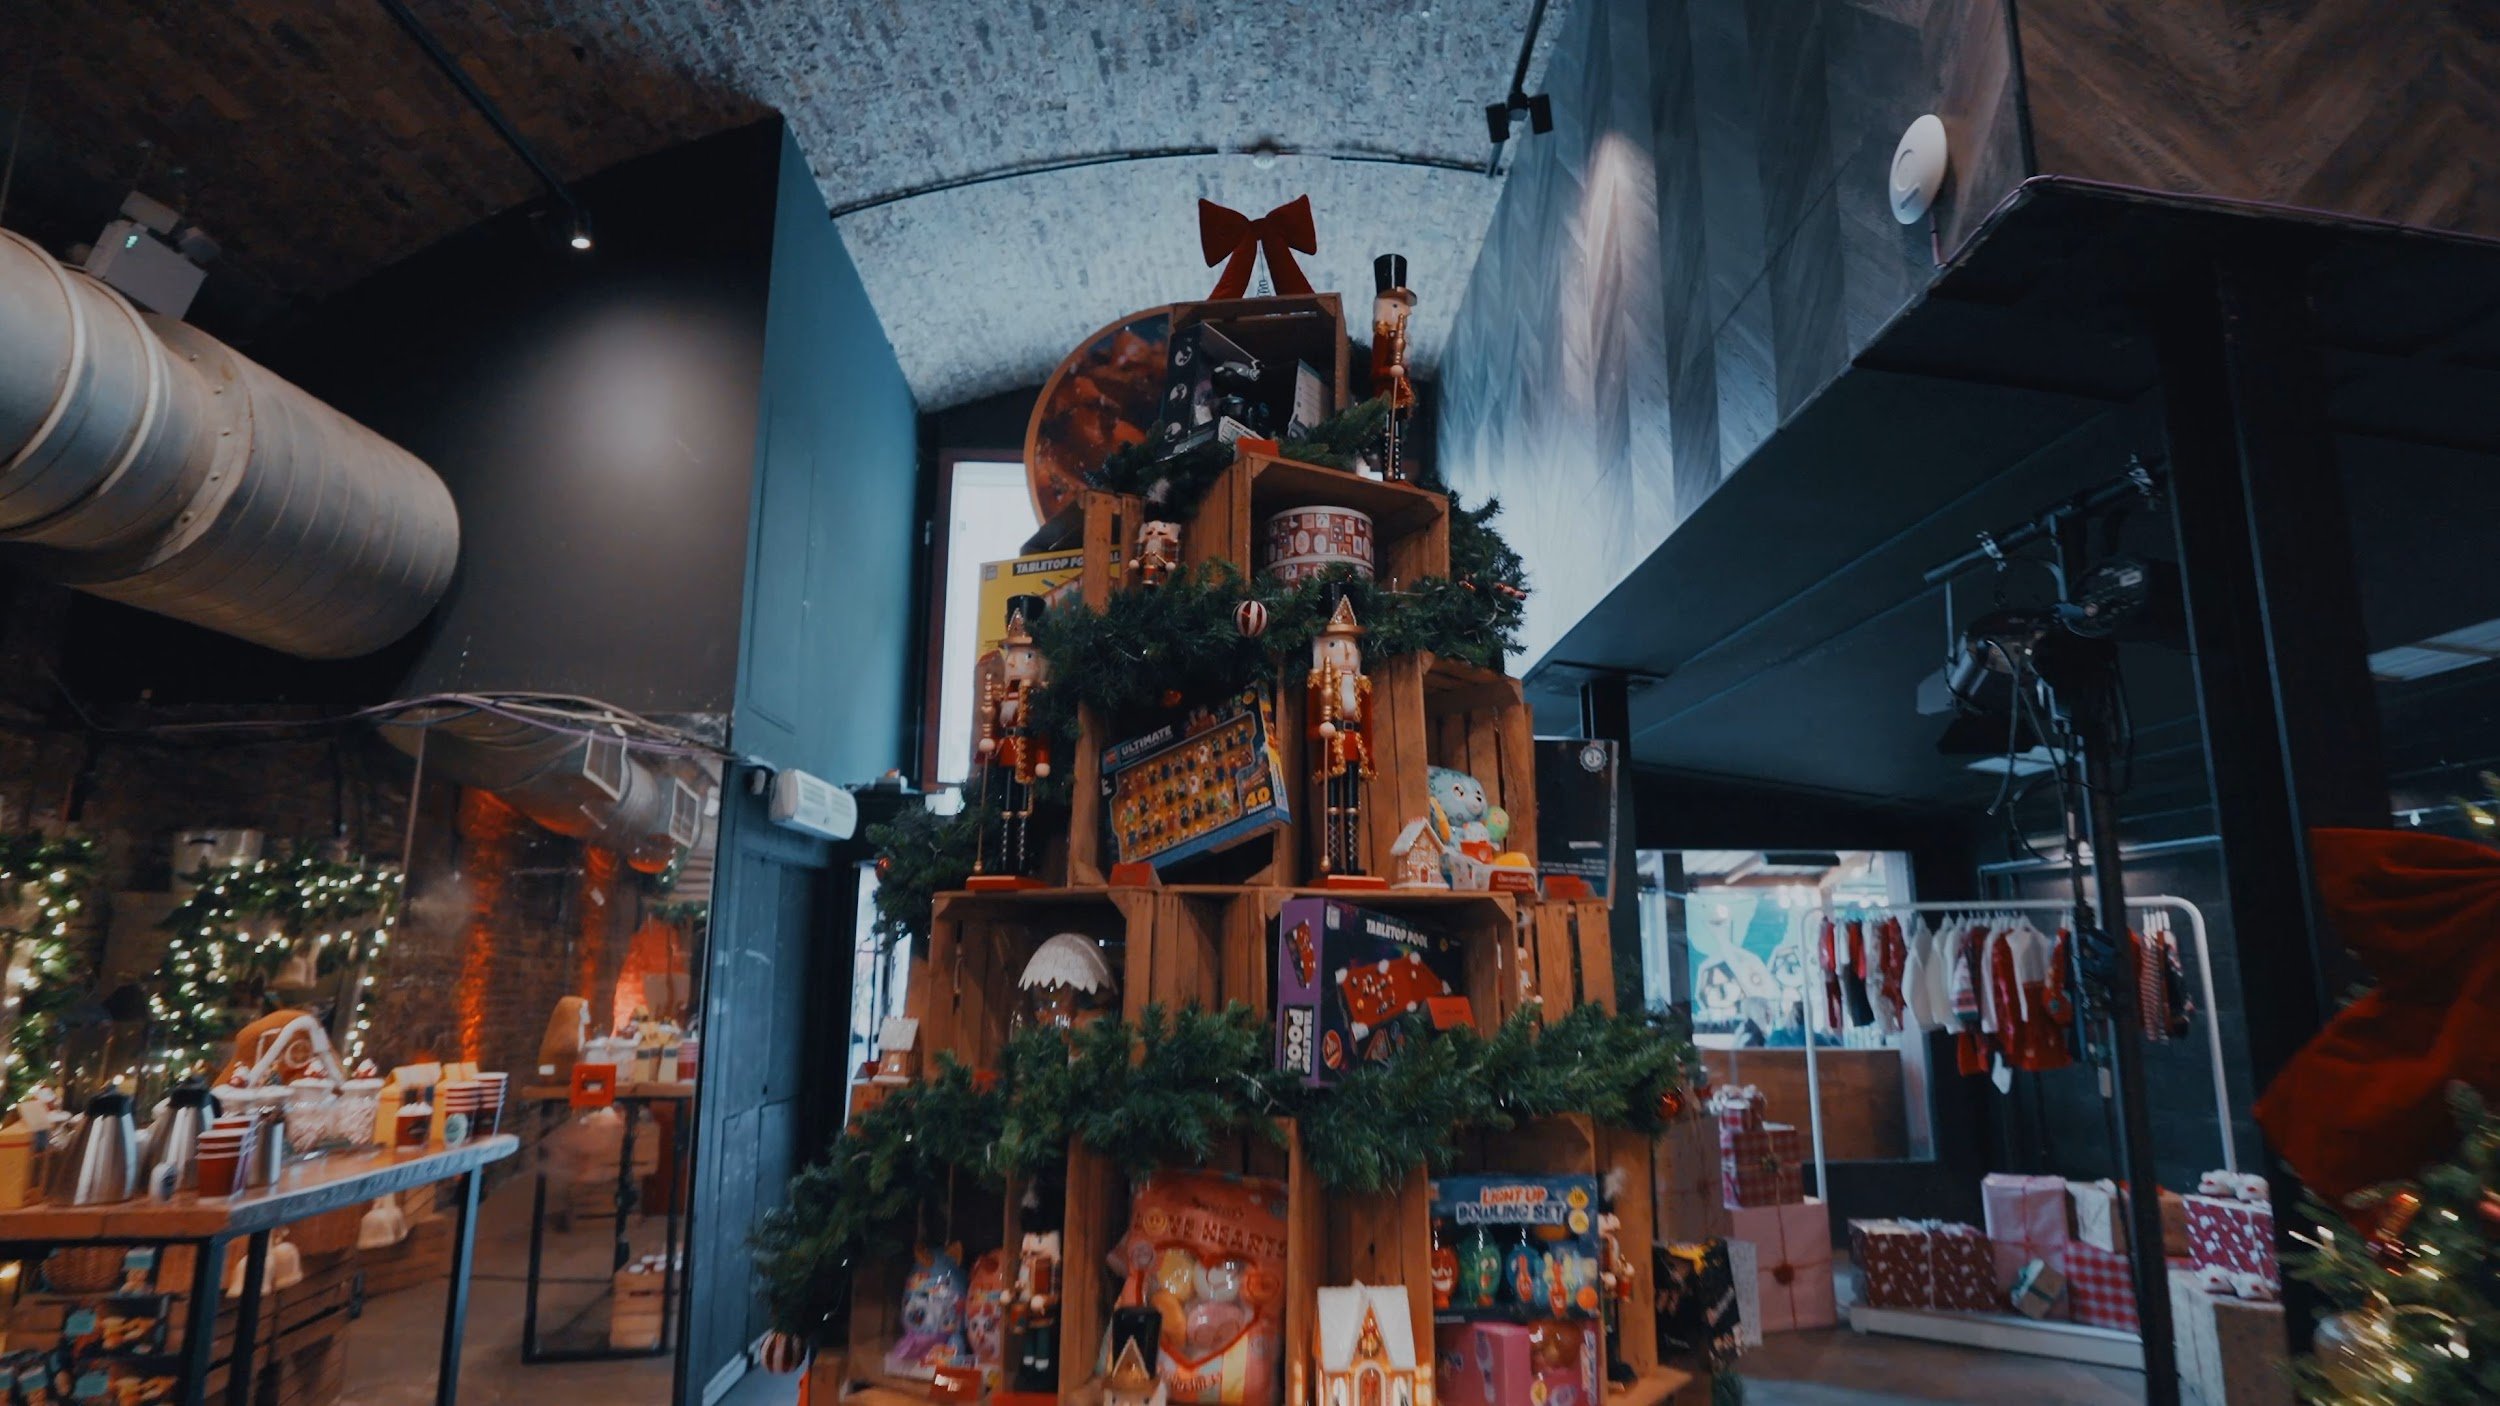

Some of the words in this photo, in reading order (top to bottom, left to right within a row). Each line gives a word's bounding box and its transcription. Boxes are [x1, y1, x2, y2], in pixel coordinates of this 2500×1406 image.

[1016, 557, 1068, 575] TABLETOP
[1121, 724, 1172, 756] ULTIMATE
[1245, 786, 1271, 808] 40
[1366, 919, 1407, 941] TABLETOP
[1407, 931, 1428, 948] POOL
[1287, 1008, 1303, 1071] POOL
[1480, 1185, 1523, 1206] LIGHT
[1524, 1185, 1549, 1205] UP
[1455, 1201, 1529, 1225] BOWLING
[1532, 1201, 1567, 1225] SET
[1202, 1221, 1287, 1257] HEARTS
